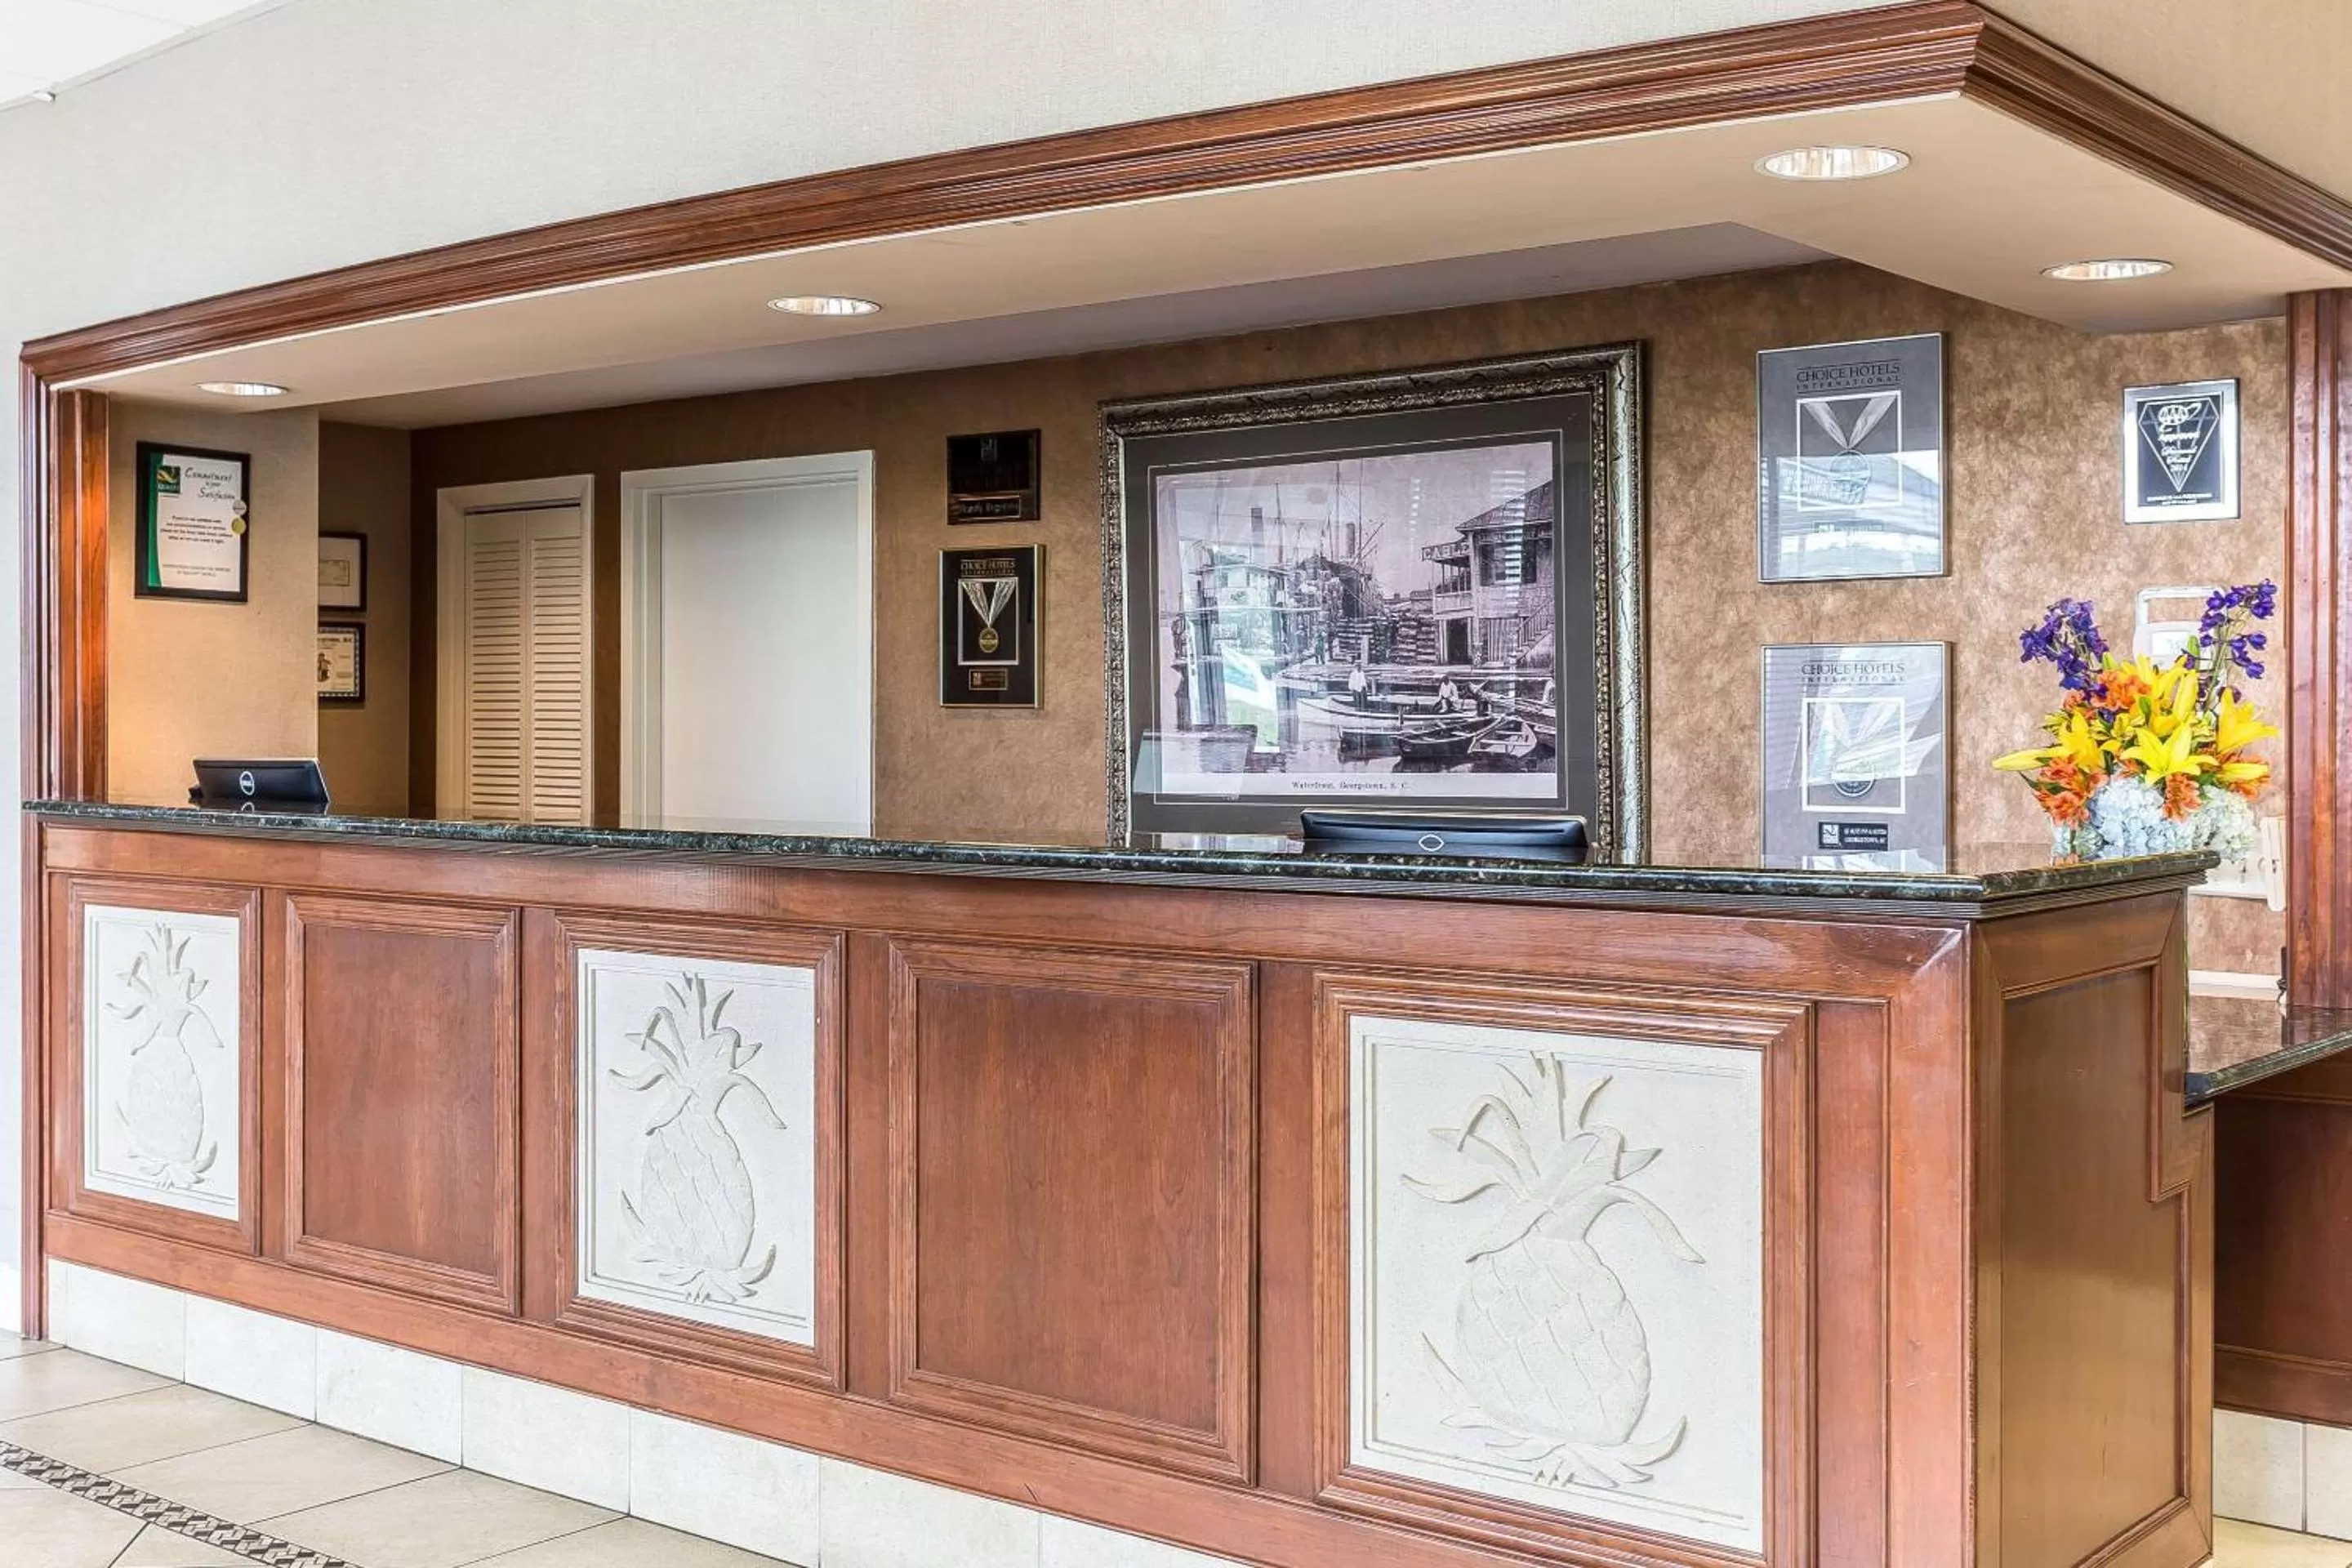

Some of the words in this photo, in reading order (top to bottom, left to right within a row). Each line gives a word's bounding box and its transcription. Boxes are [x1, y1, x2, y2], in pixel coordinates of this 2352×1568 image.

[1796, 368, 1846, 382] CHOICE
[1848, 363, 1901, 378] HOTELS
[1796, 375, 1901, 390] INTERNATIONAL
[185, 466, 233, 483] Commitment
[1800, 662, 1851, 675] CHOICE
[1853, 662, 1905, 675] HOTELS
